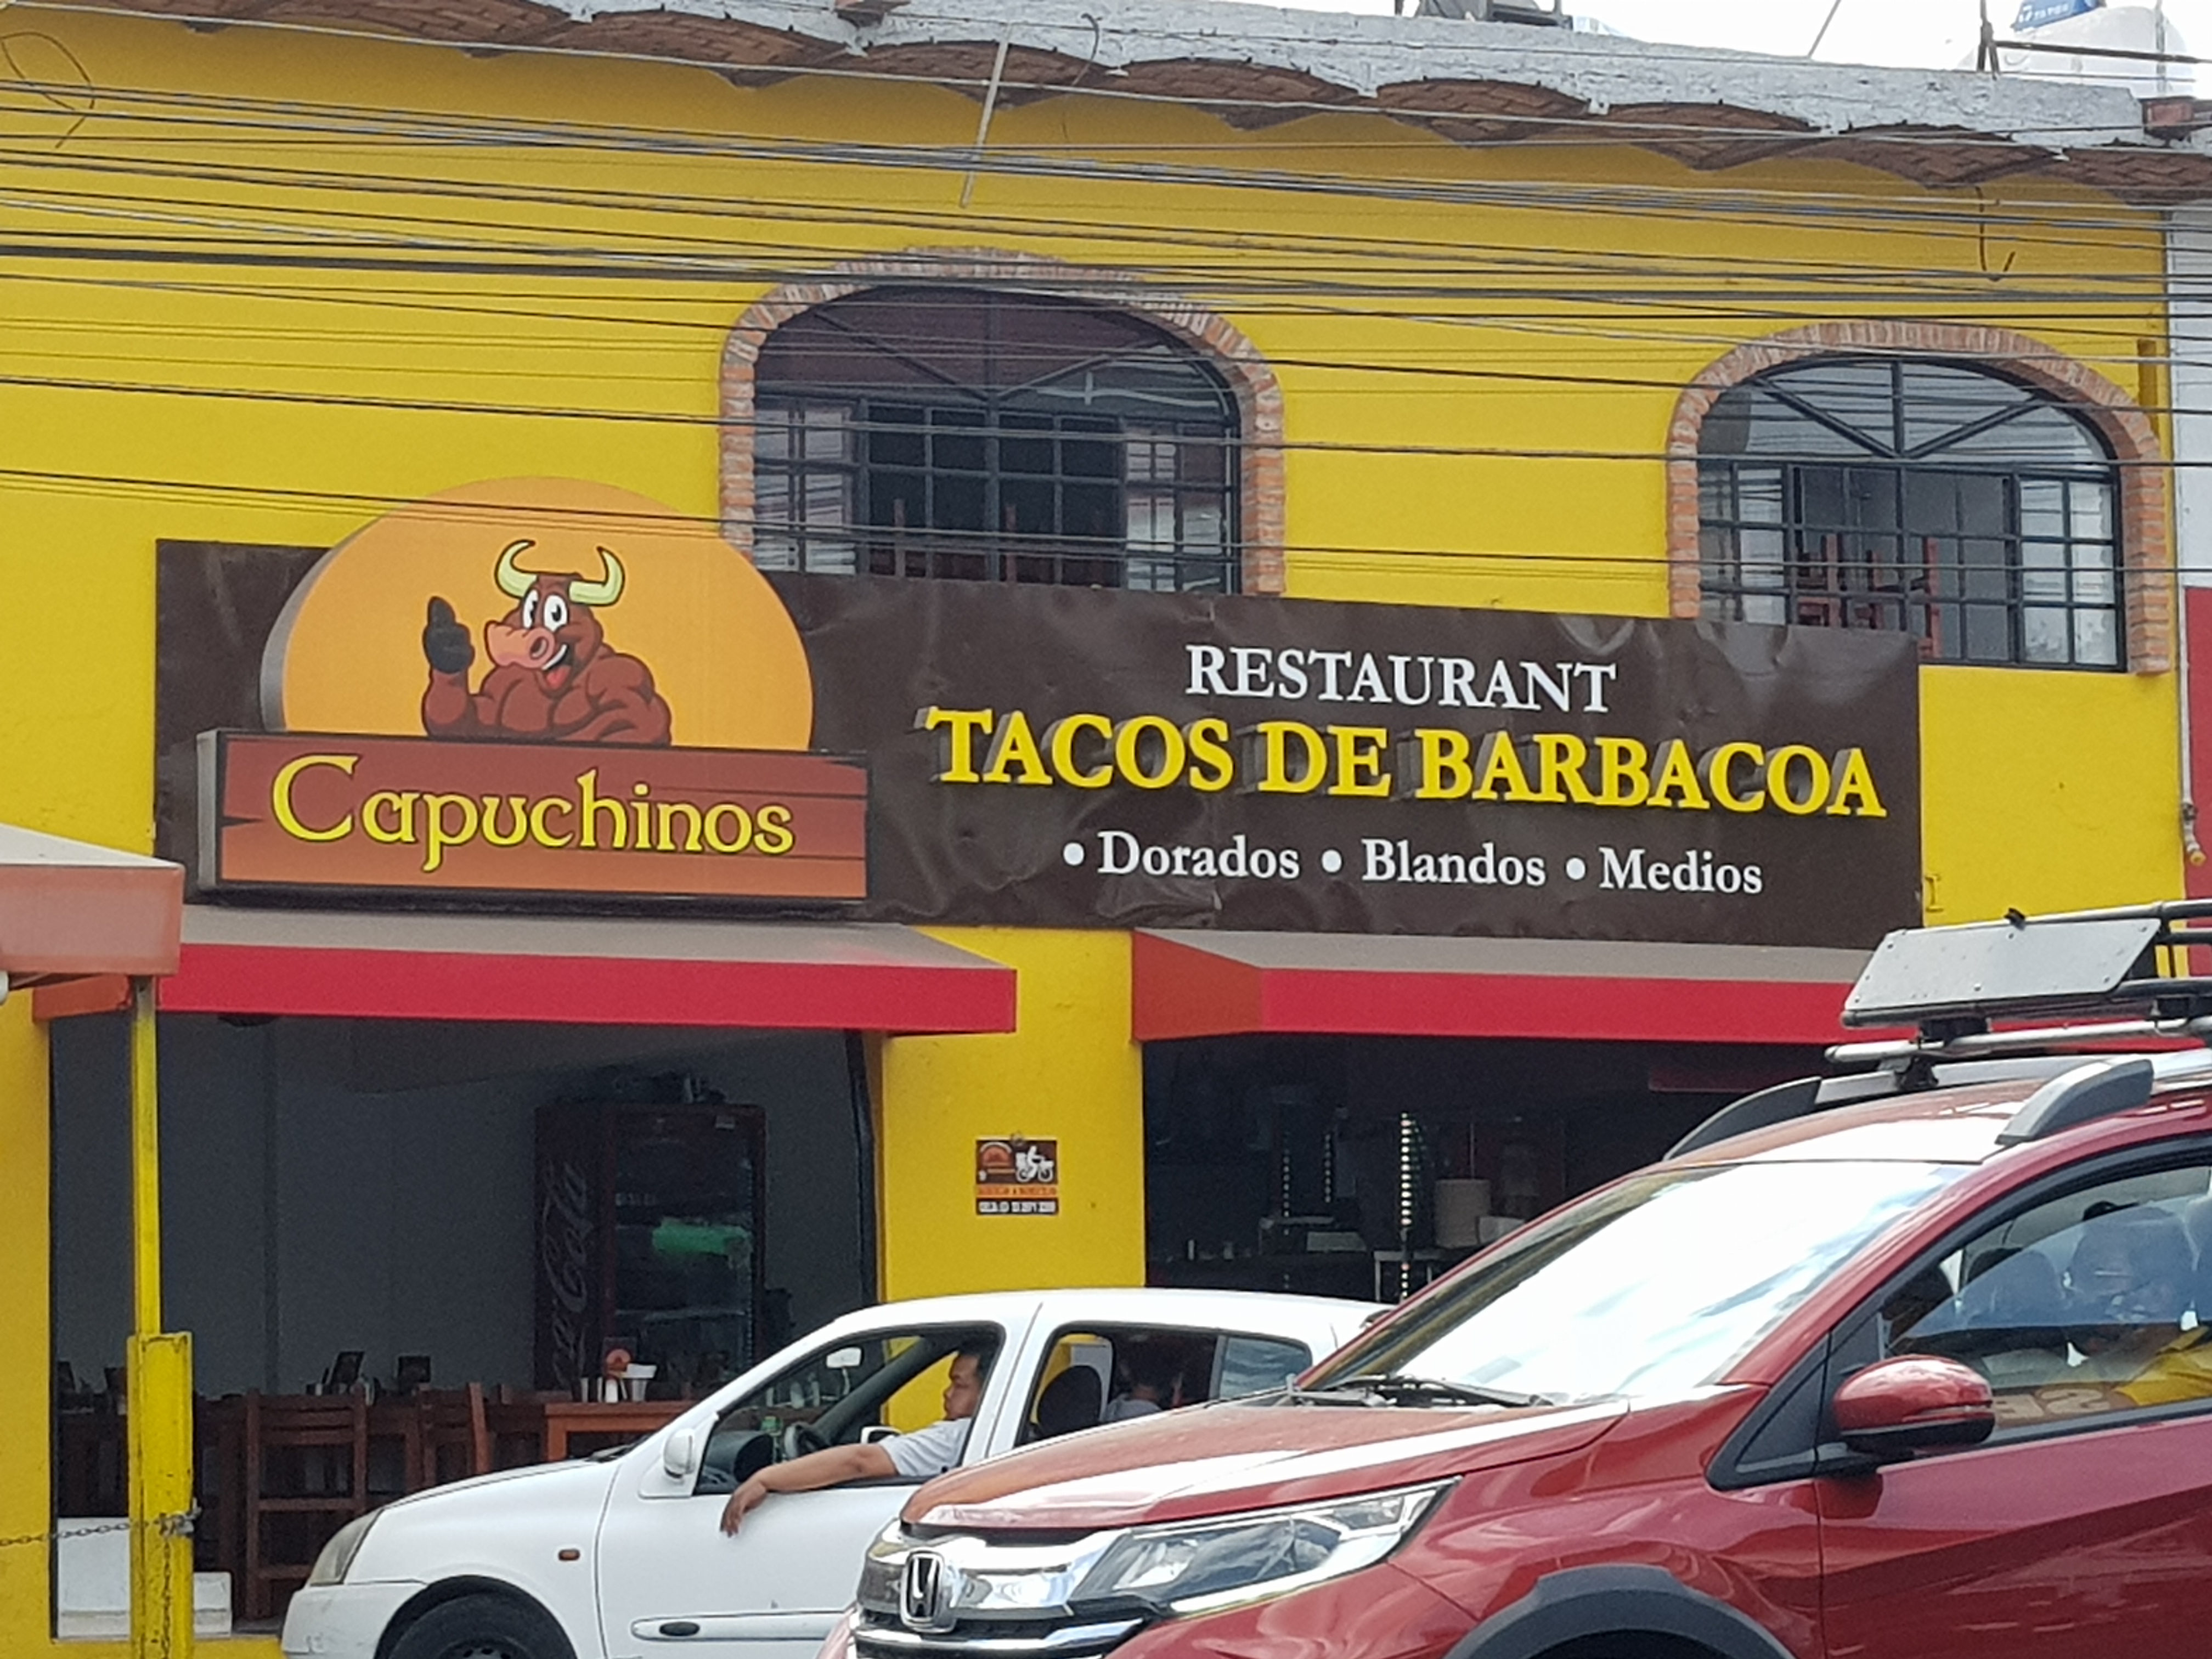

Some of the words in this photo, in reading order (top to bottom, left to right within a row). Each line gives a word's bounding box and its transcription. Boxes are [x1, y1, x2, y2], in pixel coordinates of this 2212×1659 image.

[1185, 644, 1617, 713] RESTAURANT
[923, 707, 1235, 792] TACOS
[1257, 720, 1393, 798] DE
[1414, 727, 1887, 818] BARBACOA
[272, 754, 795, 872] Capuchinos
[1097, 830, 1300, 879] Dorados
[1361, 838, 1547, 886] Blandos
[1598, 847, 1763, 894] Medios
